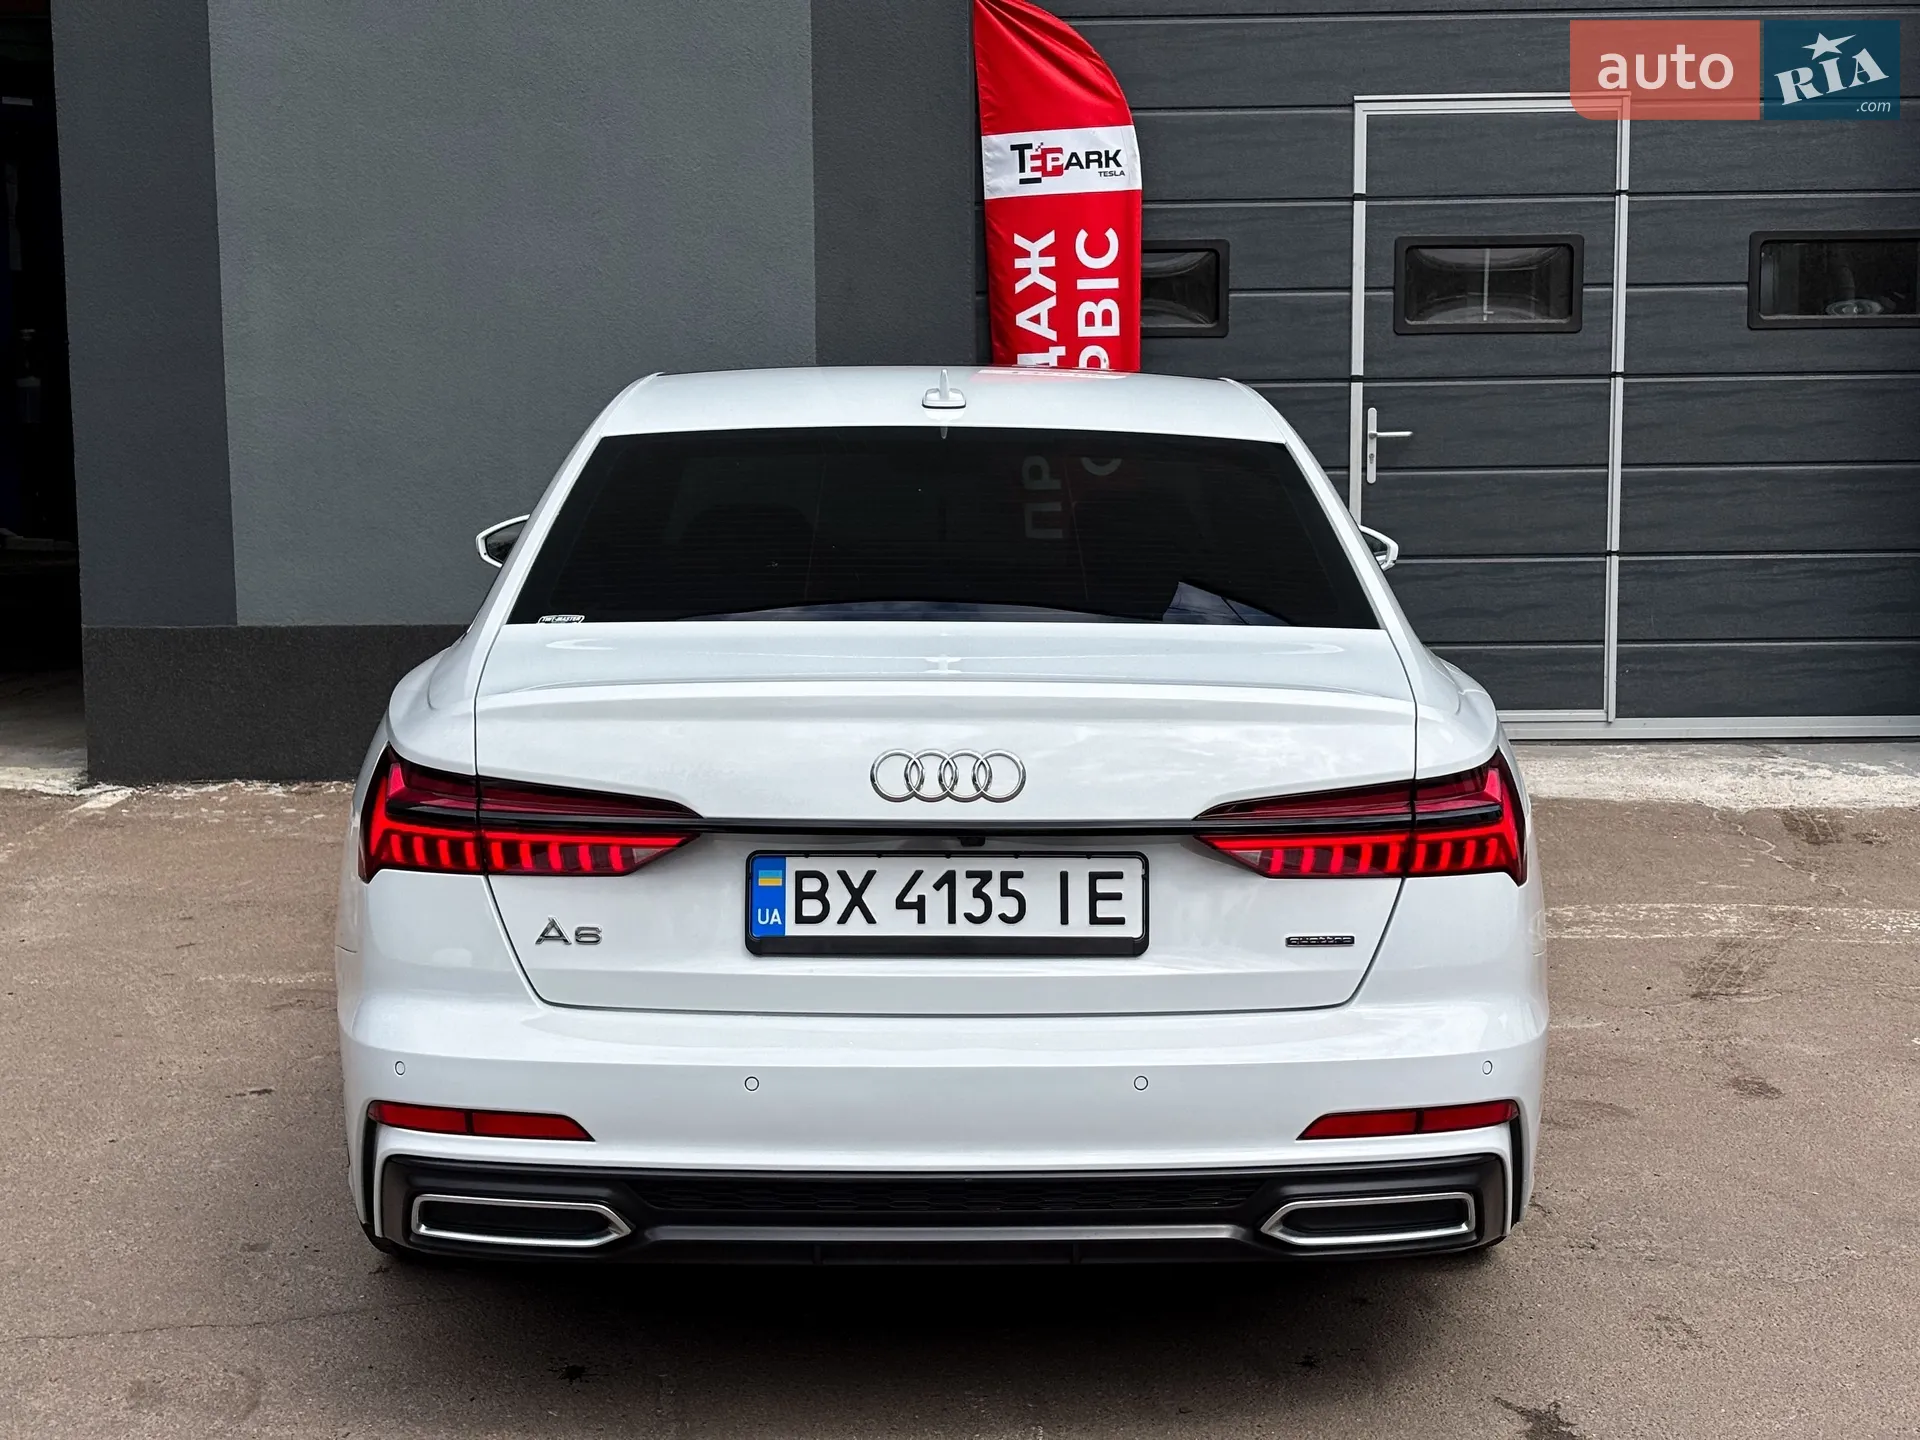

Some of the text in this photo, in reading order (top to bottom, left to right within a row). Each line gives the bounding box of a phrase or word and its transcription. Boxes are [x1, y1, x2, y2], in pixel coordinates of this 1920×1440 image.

[1098, 170, 1126, 178] TESLA
[794, 869, 1126, 925] BX 4135 IE
[757, 907, 782, 925] UA
[535, 915, 602, 945] A6
